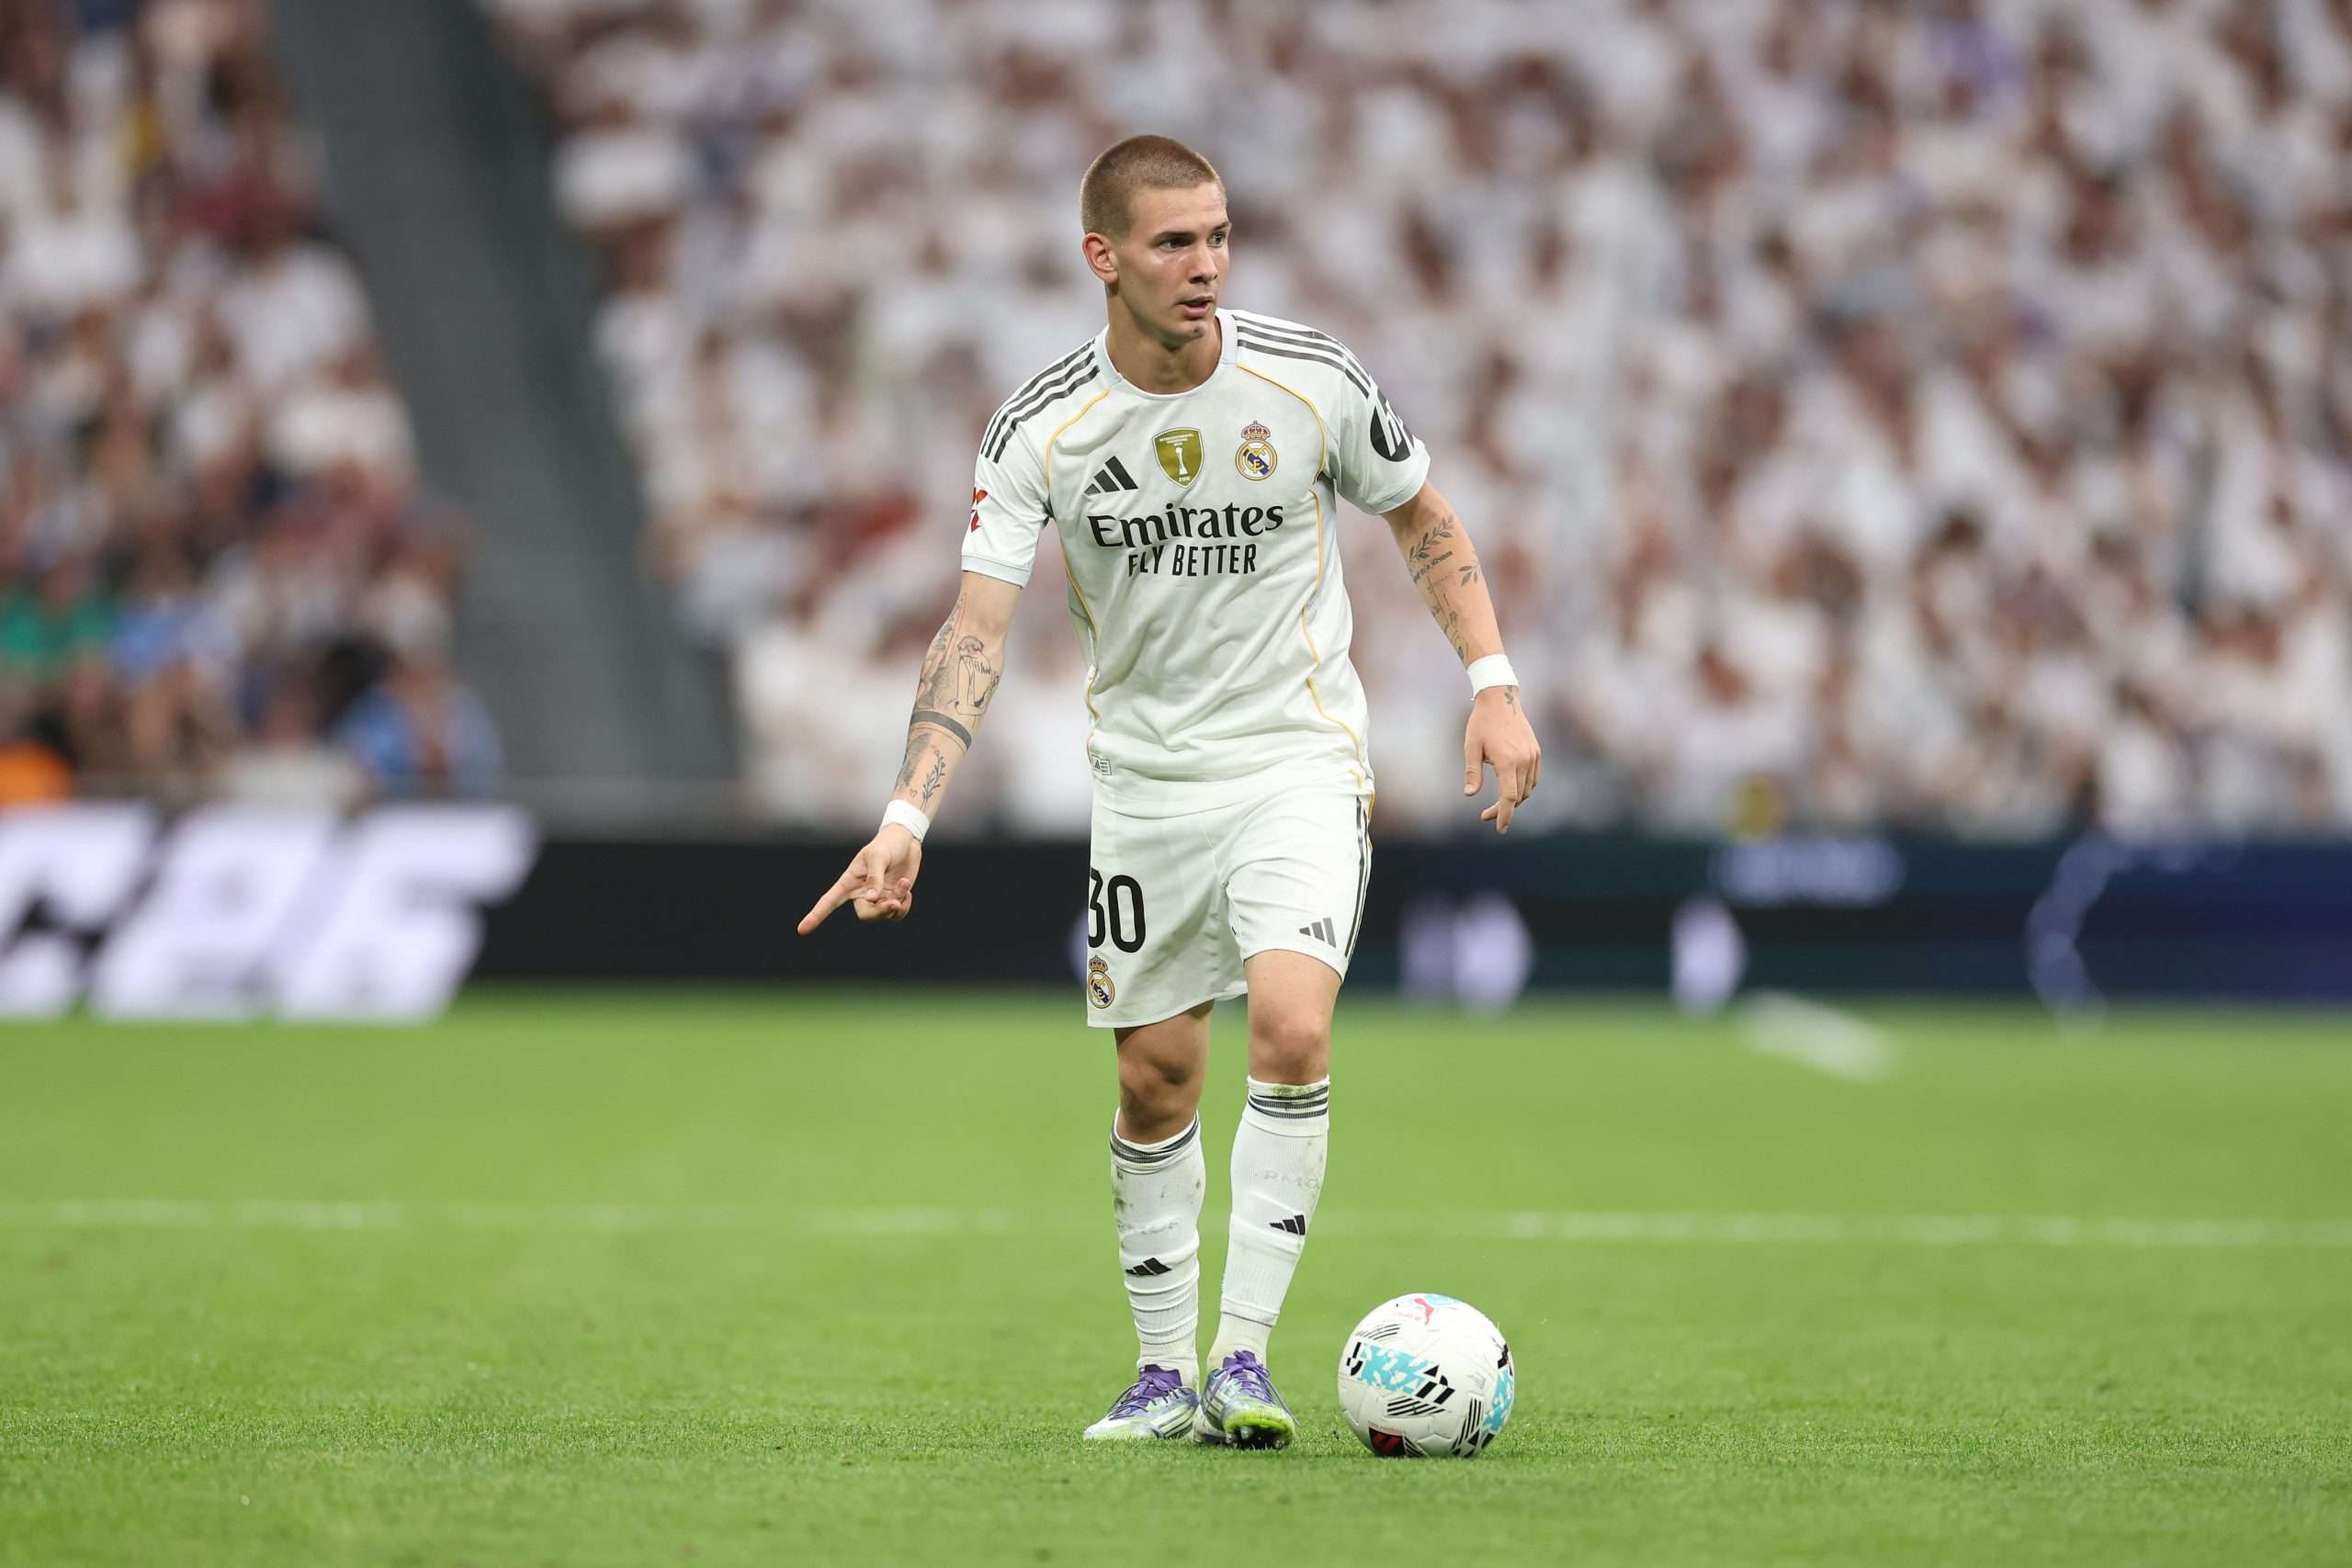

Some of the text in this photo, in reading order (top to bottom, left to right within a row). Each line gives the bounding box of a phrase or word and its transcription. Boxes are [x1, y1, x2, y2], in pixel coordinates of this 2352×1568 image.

[1087, 502, 1284, 548] Emirates
[1128, 543, 1257, 577] FLY BETTER
[1088, 867, 1147, 953] 30
